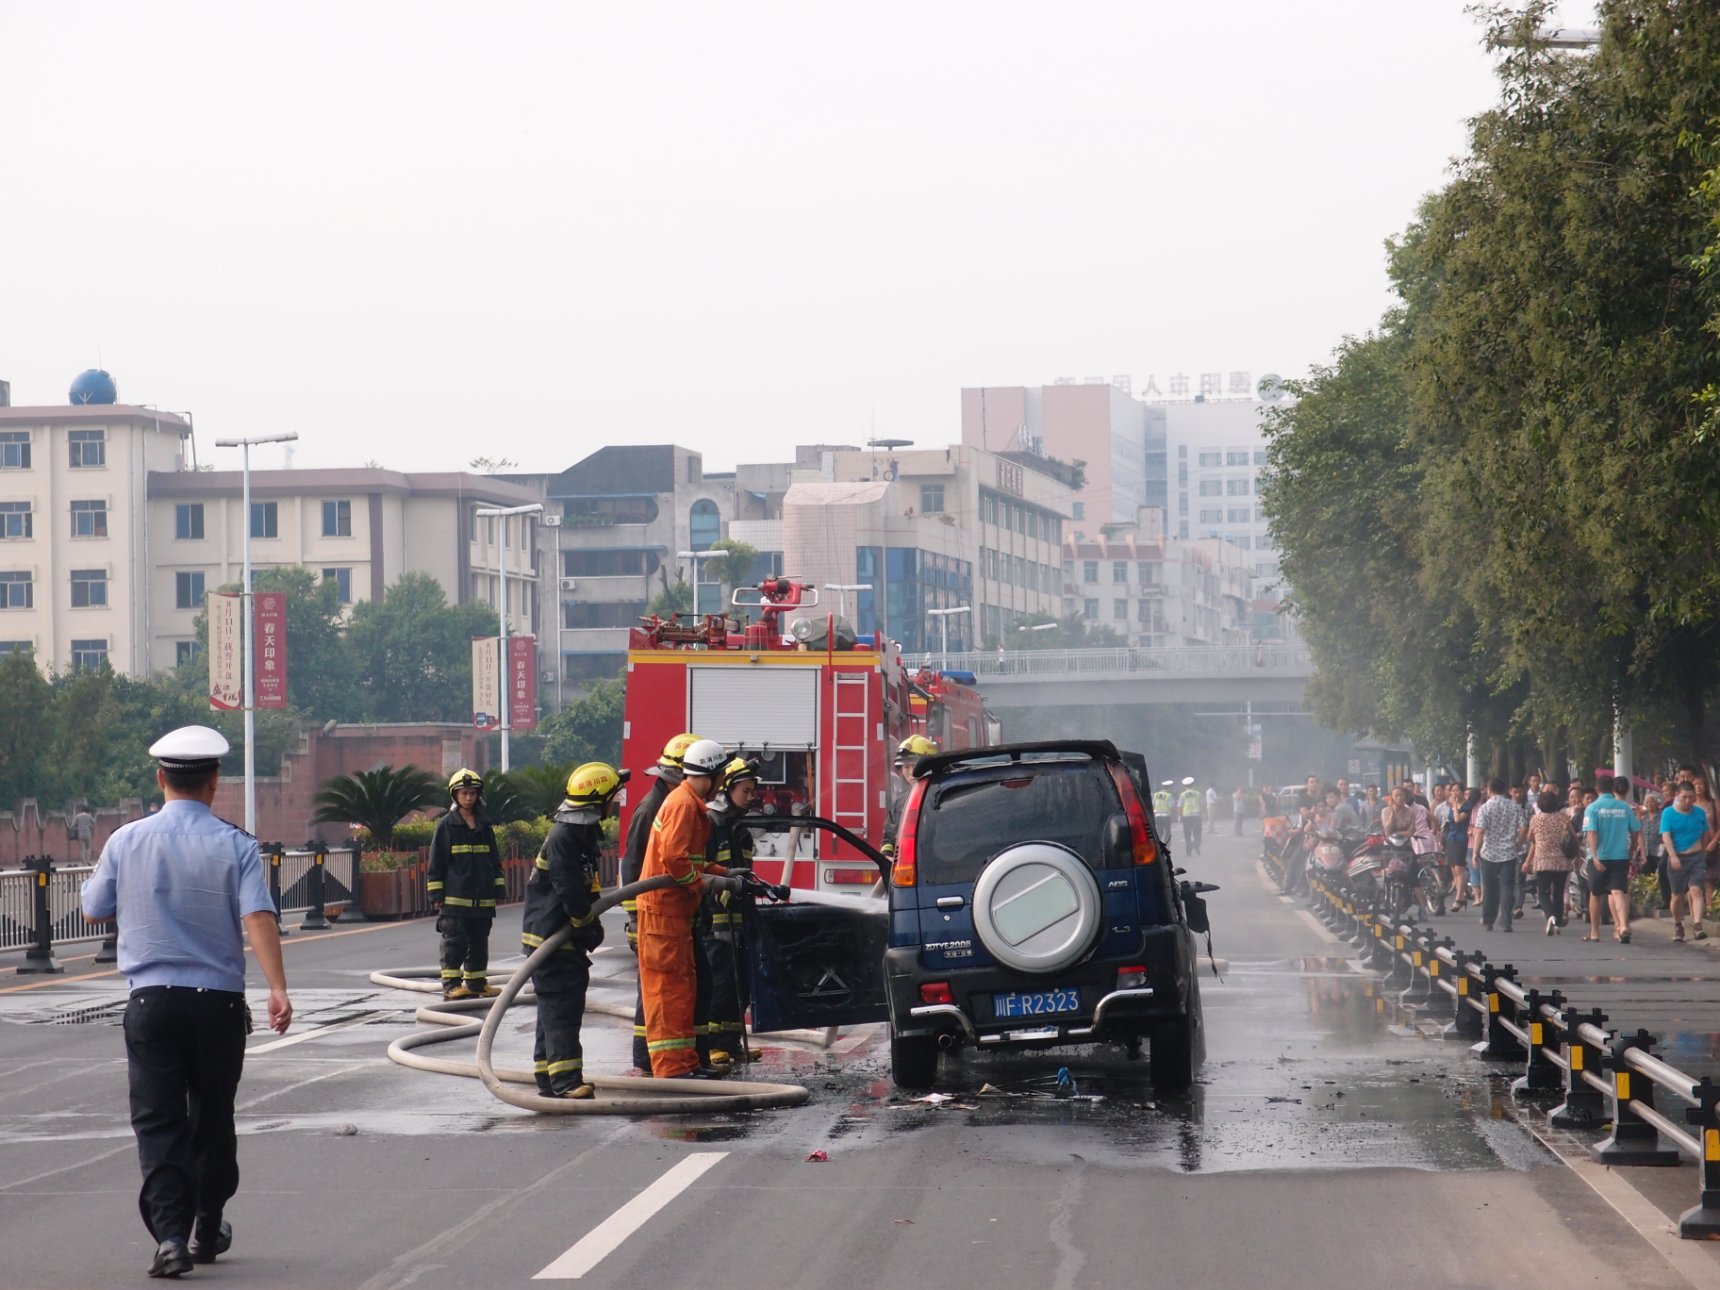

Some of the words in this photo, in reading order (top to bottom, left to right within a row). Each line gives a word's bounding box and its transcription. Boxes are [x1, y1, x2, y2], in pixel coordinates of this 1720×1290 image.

[264, 623, 275, 671] 春天印象
[517, 661, 525, 699] 春天印象
[1108, 880, 1128, 888] ABS
